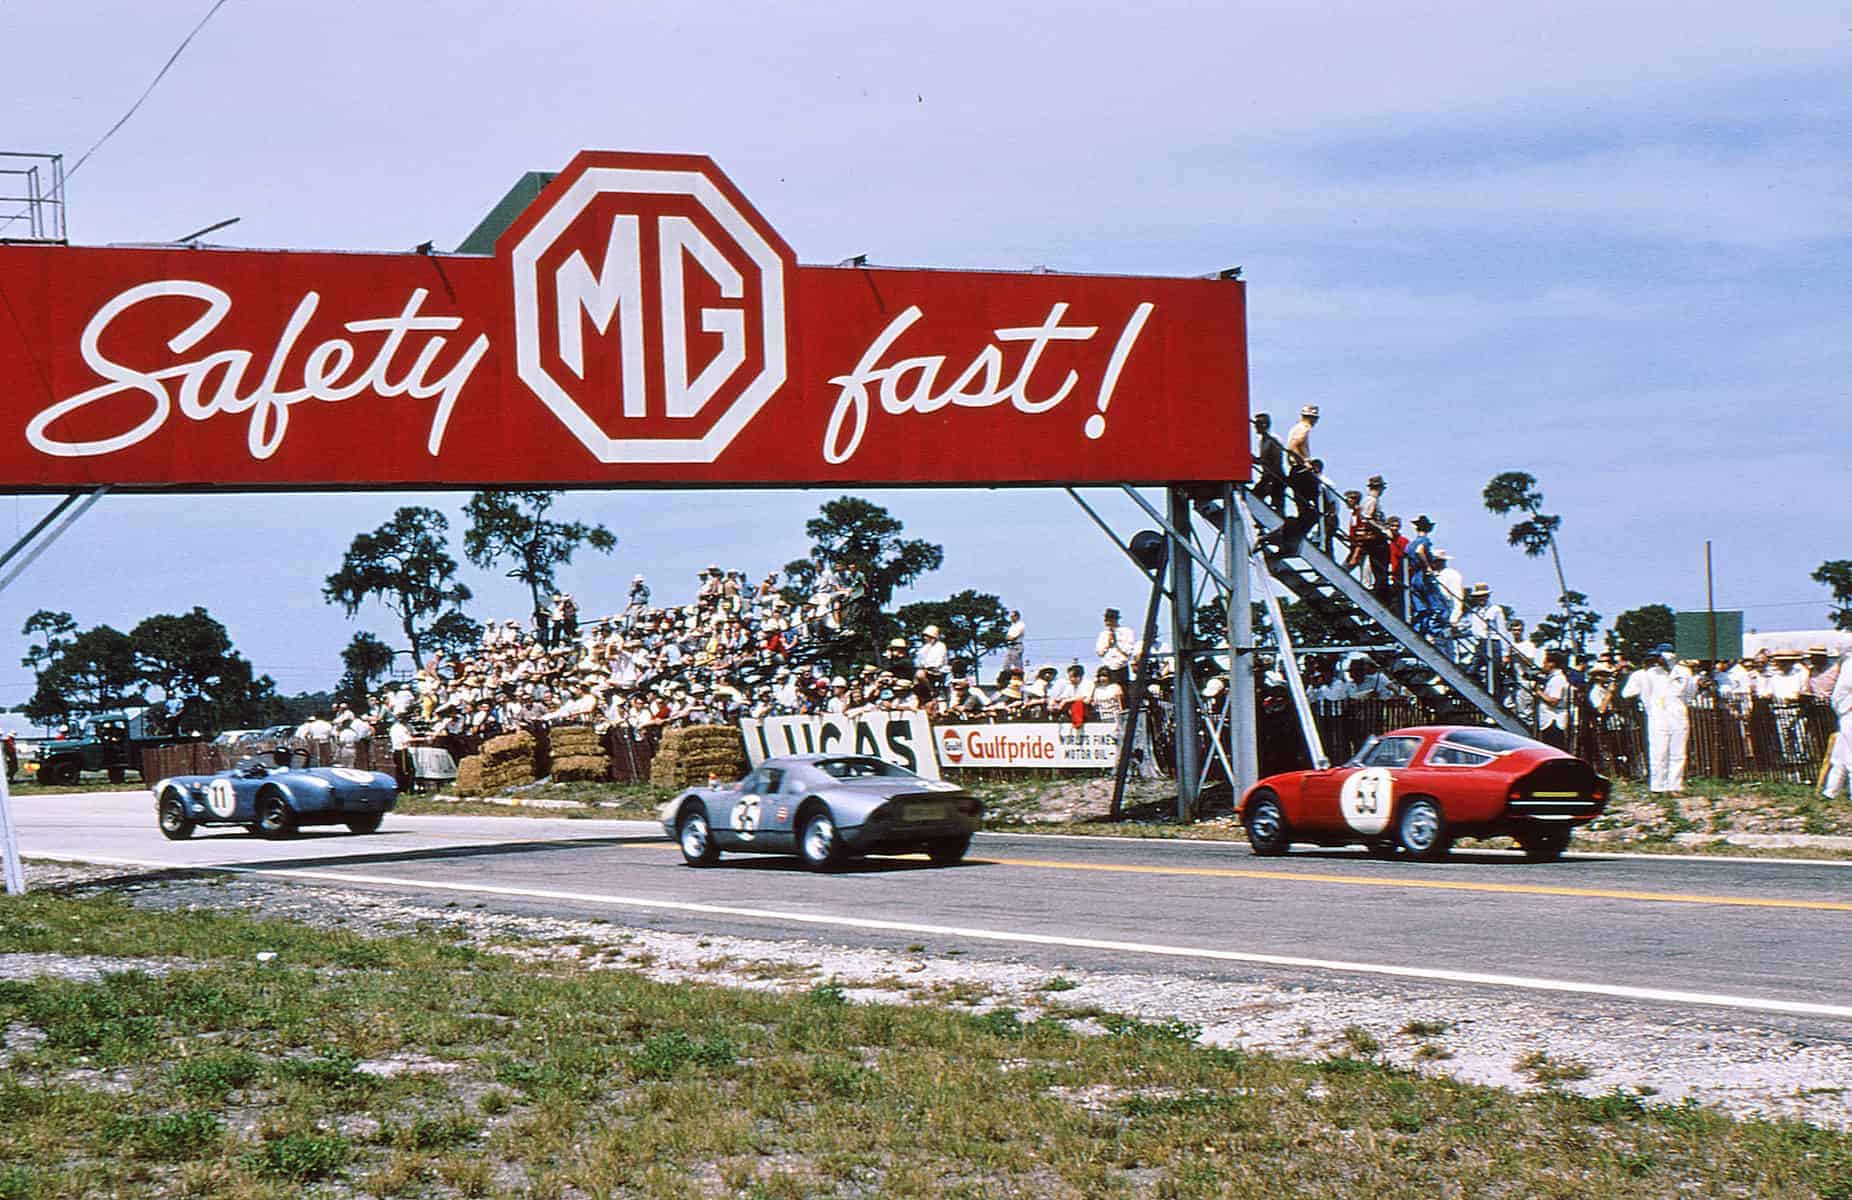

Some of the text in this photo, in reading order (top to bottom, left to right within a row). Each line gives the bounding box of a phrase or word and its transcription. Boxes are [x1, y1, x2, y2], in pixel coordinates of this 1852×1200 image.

[26, 214, 1153, 464] Safety MG fast!
[967, 730, 1055, 763] Gulfpride
[1063, 749, 1091, 760] MOTOR
[212, 786, 226, 808] 11
